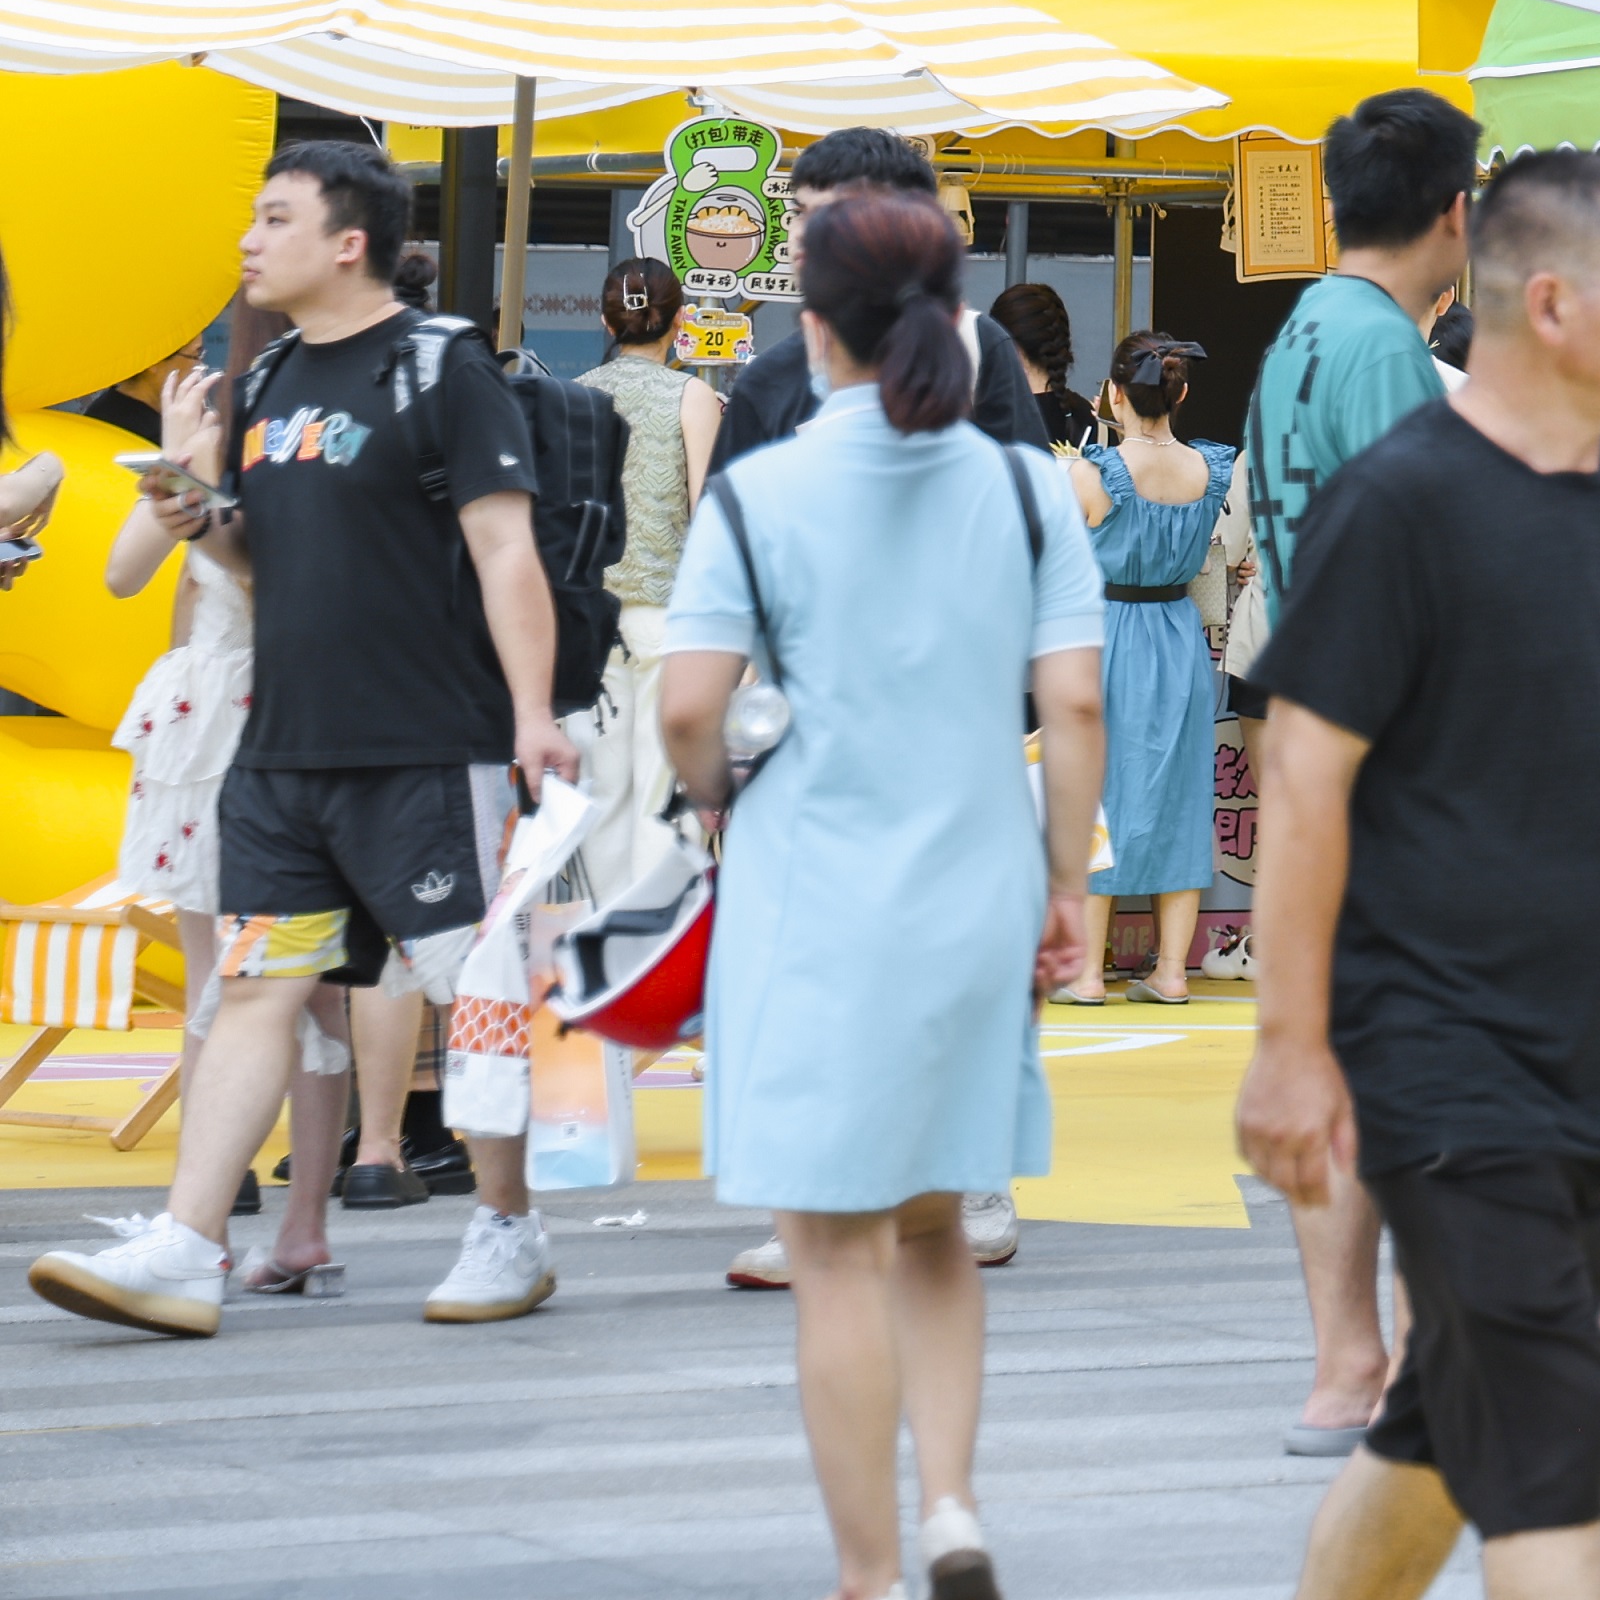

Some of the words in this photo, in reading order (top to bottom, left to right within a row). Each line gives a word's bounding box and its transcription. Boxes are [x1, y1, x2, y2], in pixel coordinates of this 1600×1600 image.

[671, 198, 687, 232] TAKE
[766, 198, 784, 226] AKE
[671, 234, 689, 271] AWAY
[705, 331, 724, 346] 20
